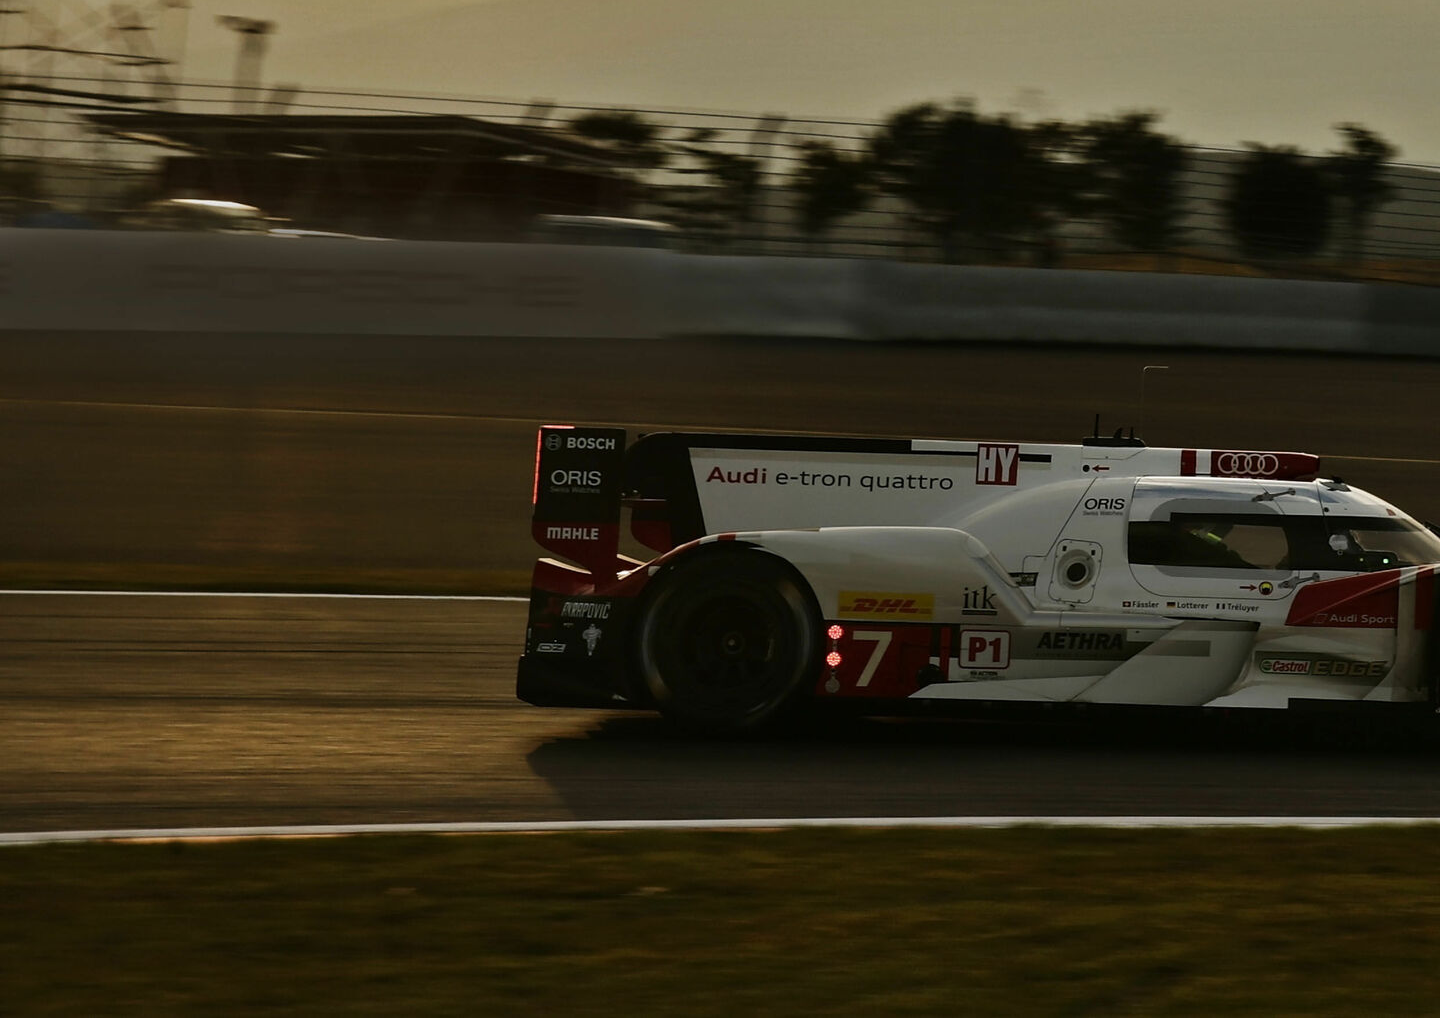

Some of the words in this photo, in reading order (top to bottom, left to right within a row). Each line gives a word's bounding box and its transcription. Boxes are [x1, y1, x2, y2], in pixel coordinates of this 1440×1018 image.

[566, 437, 616, 451] BOSCH
[977, 446, 1018, 483] HY
[550, 469, 602, 486] ORIS
[707, 466, 767, 484] Audi
[775, 470, 851, 487] e-tron
[860, 474, 953, 491] quattro
[1084, 498, 1125, 510] ORIS
[546, 526, 599, 541] MAHLE
[852, 597, 920, 614] DHL
[962, 585, 997, 609] itk
[1177, 601, 1209, 610] Lotterer
[1328, 614, 1358, 623] Audi
[1361, 614, 1396, 625] Sport
[968, 636, 1002, 663] P1
[1037, 632, 1124, 650] AETHRA
[852, 630, 893, 688] 7
[1272, 661, 1308, 672] Castrol
[1311, 661, 1388, 677] EDGE
